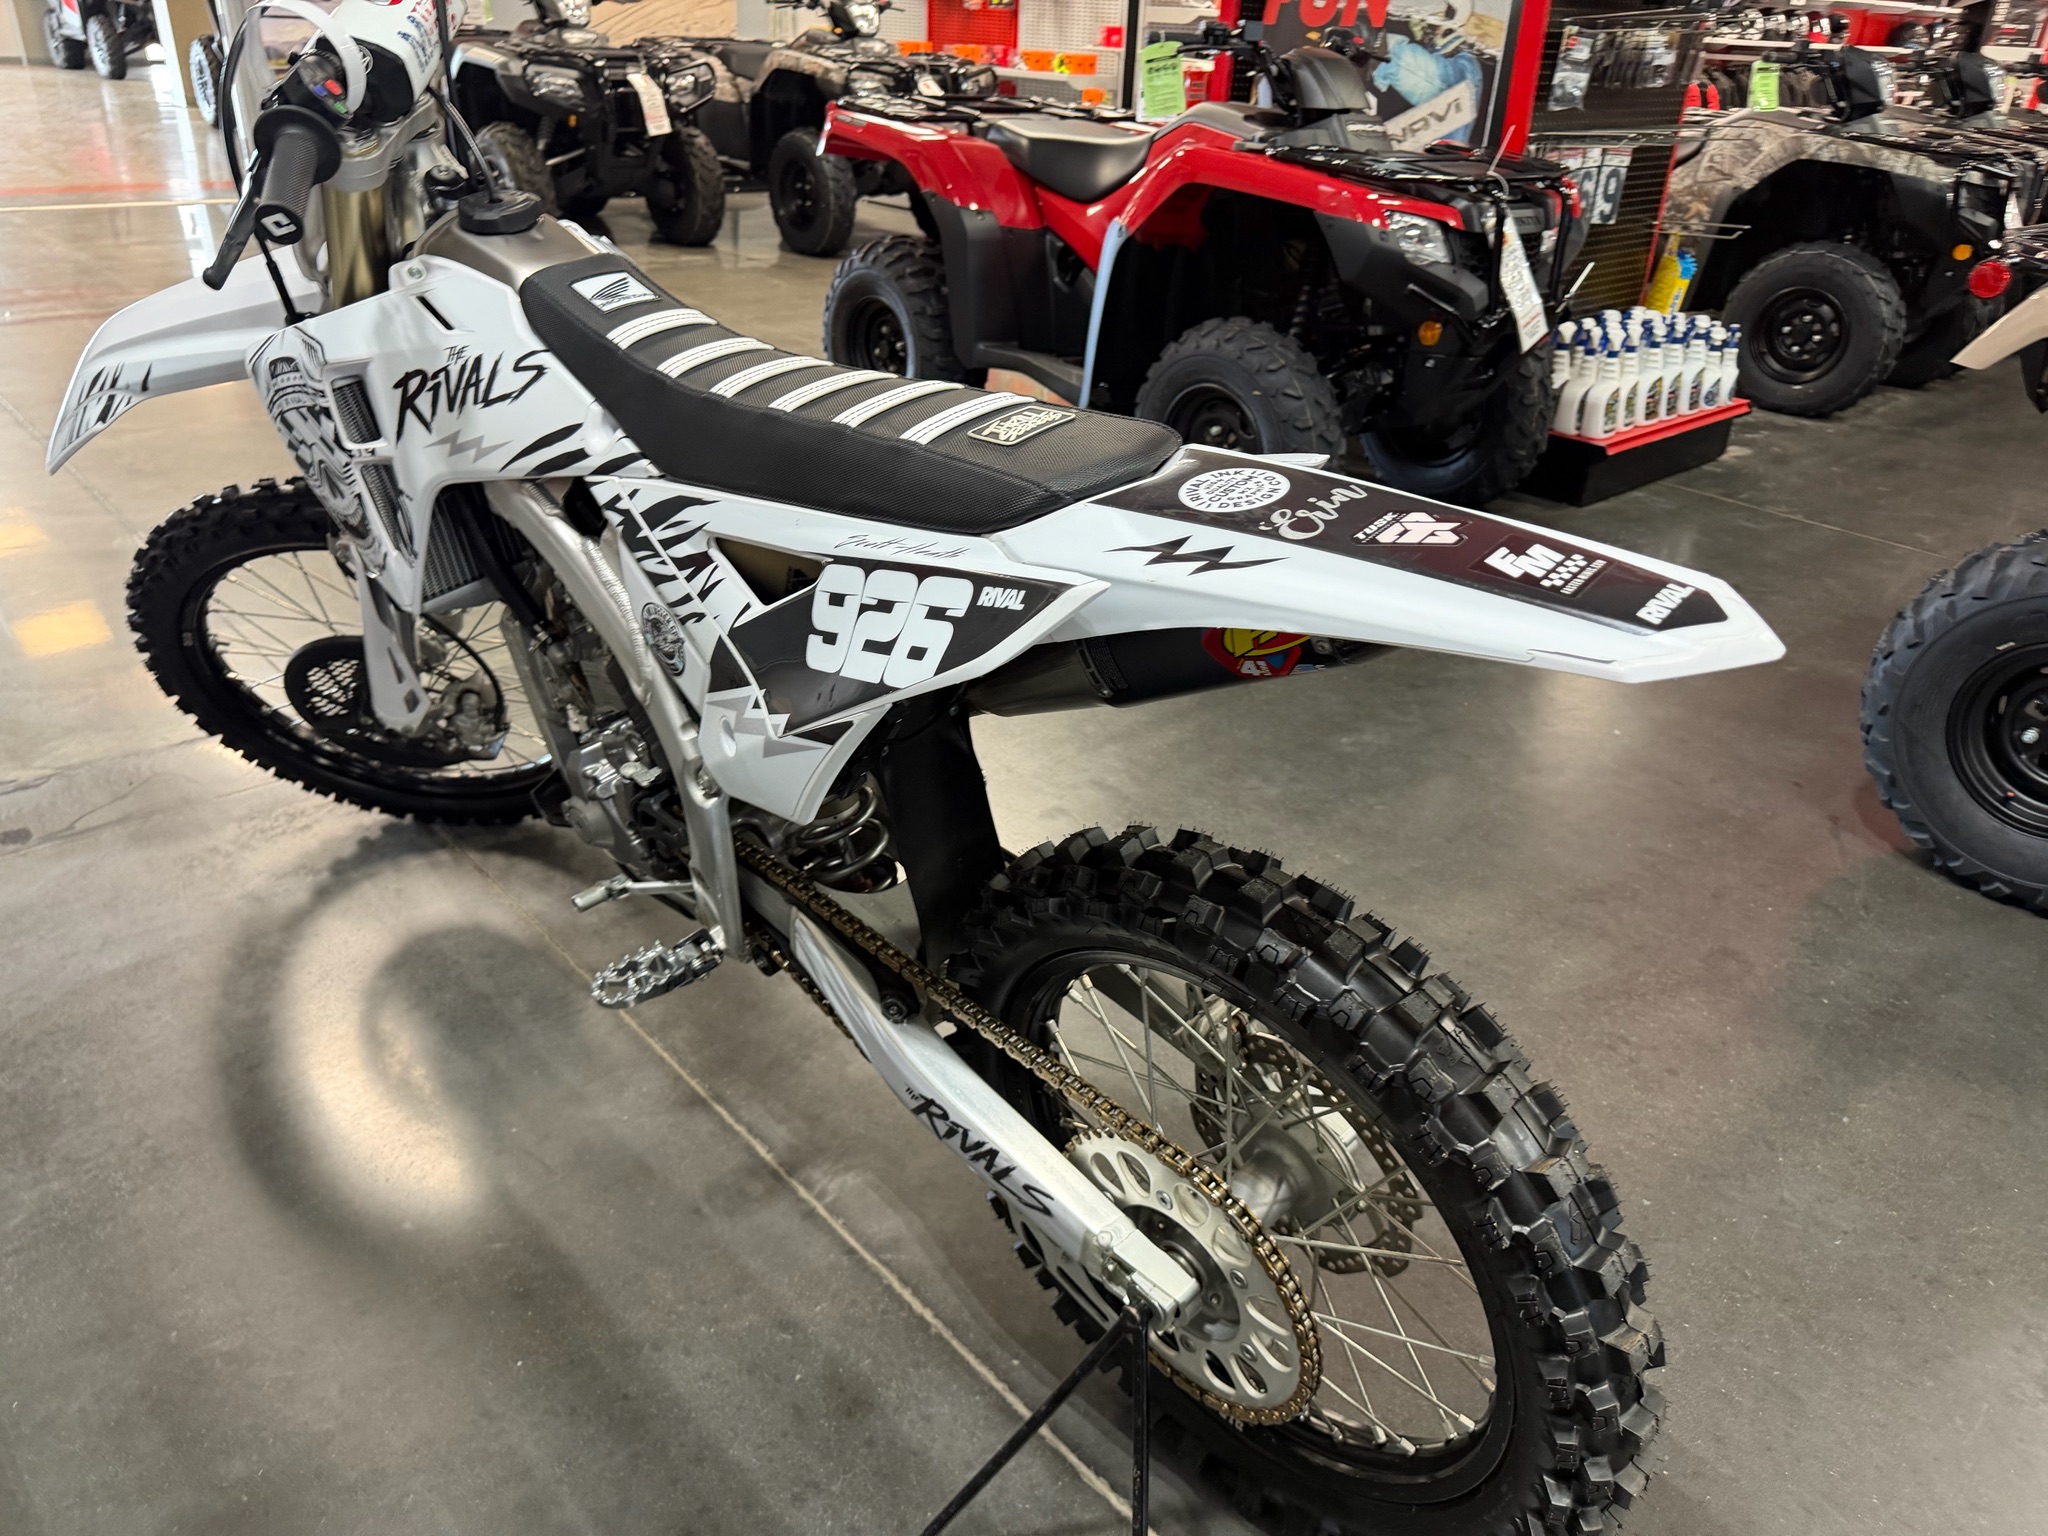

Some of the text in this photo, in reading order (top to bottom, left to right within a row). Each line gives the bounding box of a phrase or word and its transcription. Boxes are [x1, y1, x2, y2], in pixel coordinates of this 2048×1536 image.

[443, 344, 470, 365] THE
[1185, 470, 1245, 502] RIVAL INK
[1208, 475, 1258, 502] CUSTOM
[1218, 475, 1281, 508] DESIGN CO
[1353, 511, 1399, 540] TUSK
[976, 586, 1027, 611] RIVAL
[1636, 583, 1695, 625] RIVAL
[805, 563, 974, 689] 926
